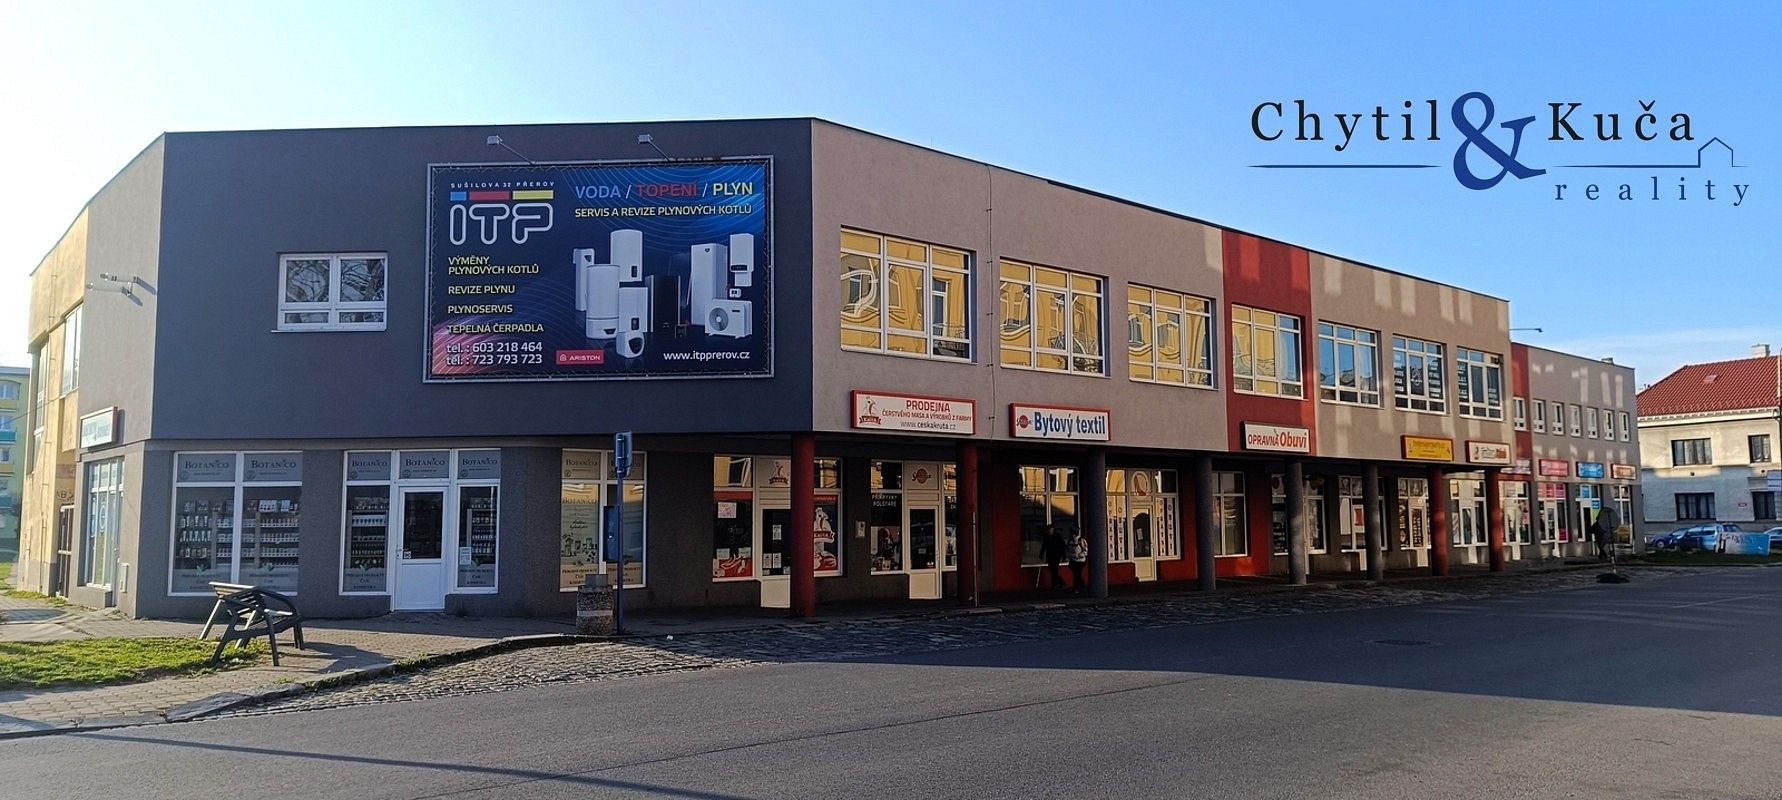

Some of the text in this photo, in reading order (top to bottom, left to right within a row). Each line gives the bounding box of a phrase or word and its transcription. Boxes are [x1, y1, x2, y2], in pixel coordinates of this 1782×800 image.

[450, 181, 500, 189] SUŠILOVA
[516, 180, 555, 188] PŘEROV
[575, 184, 622, 199] VODA
[636, 182, 698, 198] TOPENÍ
[712, 181, 753, 196] PLYN
[575, 203, 752, 217] SERVIS A REVIZE PLYNOVÝCH KOTLŮ
[449, 202, 554, 246] ITP
[448, 255, 490, 265] VÝMĚNY
[448, 263, 539, 275] PLYNOVÝCH KOTLŮ
[448, 285, 516, 294] REVIZE PLYNU
[447, 304, 513, 314] PLYNOSERVIS
[447, 322, 544, 333] TEPELNÁ ČERPADLA
[472, 342, 494, 352] 603
[496, 342, 519, 352] 218
[521, 342, 543, 352] 464
[472, 355, 494, 365] 723
[496, 354, 519, 365] 793
[521, 354, 543, 364] 723
[663, 350, 751, 362] www.itpprerov.cz
[906, 400, 950, 412] PRODEJNA
[1034, 411, 1073, 438] Bytový
[1076, 415, 1106, 435] textil
[1247, 431, 1307, 448] OPRAVNA Obuvi
